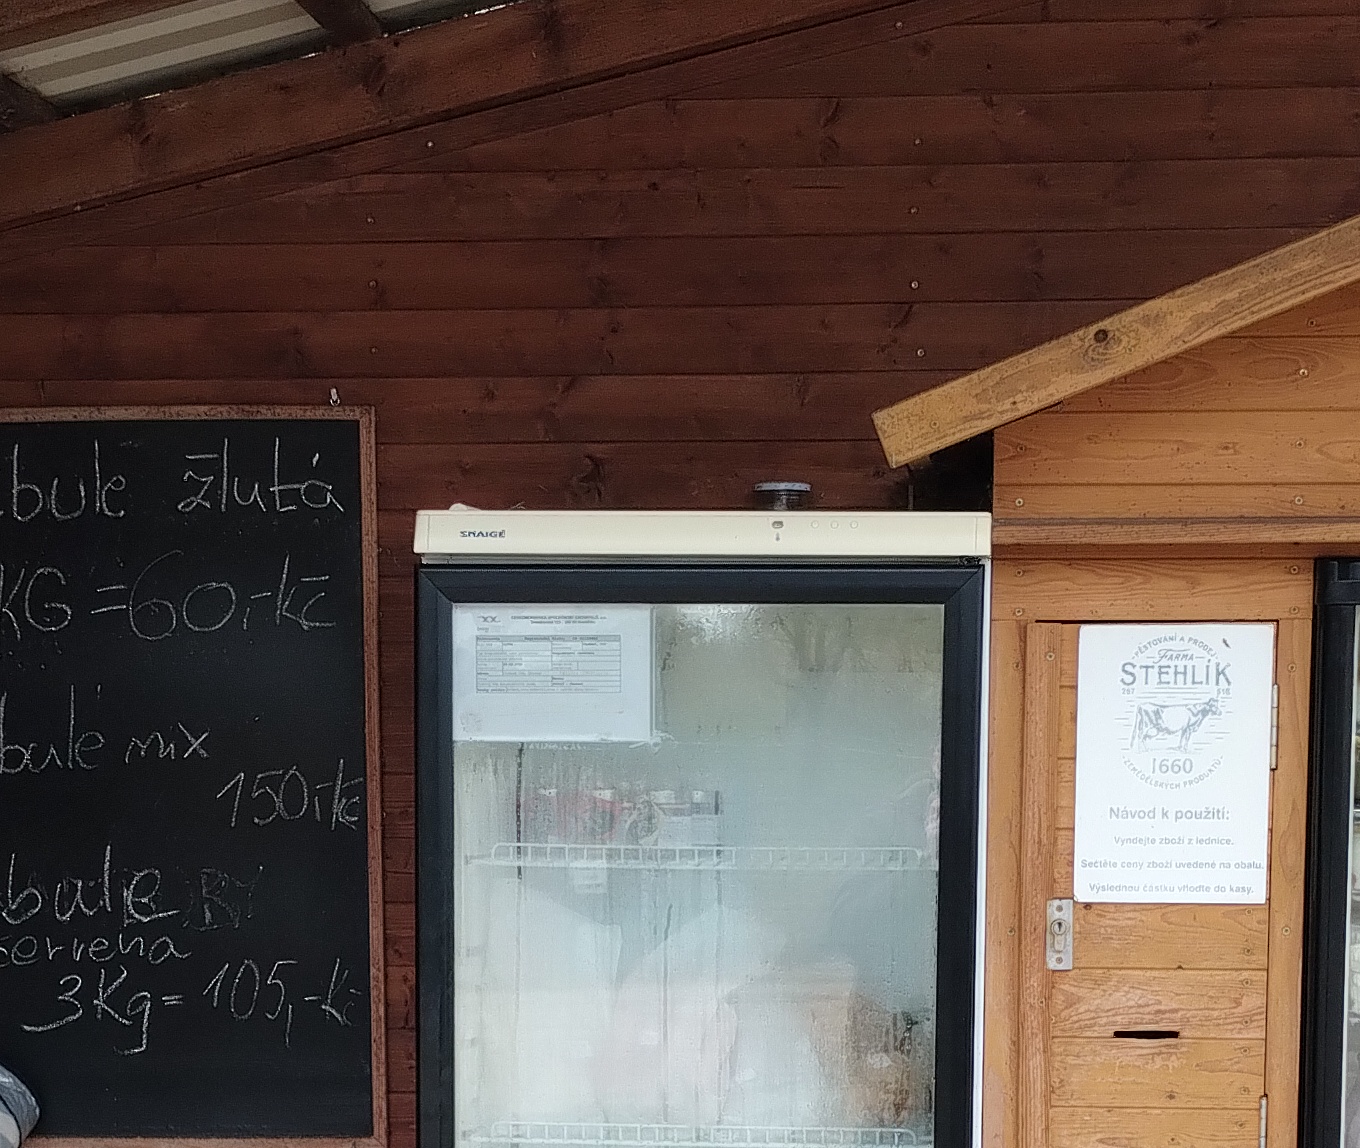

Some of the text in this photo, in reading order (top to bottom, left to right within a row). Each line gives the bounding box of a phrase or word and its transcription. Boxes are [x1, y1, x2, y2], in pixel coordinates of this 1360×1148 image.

[1120, 659, 1232, 686] STEHLÍK
[1152, 757, 1194, 775] 1660
[1109, 806, 1230, 822] Návod k použití:
[1114, 835, 1235, 847] Vyndejte zboží z lednice.
[1080, 859, 1118, 869] Sečtěte
[1120, 861, 1144, 872] ceny
[1146, 859, 1173, 869] zboží
[1174, 859, 1217, 869] uvedené
[1219, 861, 1231, 870] na
[1089, 883, 1140, 895] Výslednou
[1213, 884, 1227, 893] do
